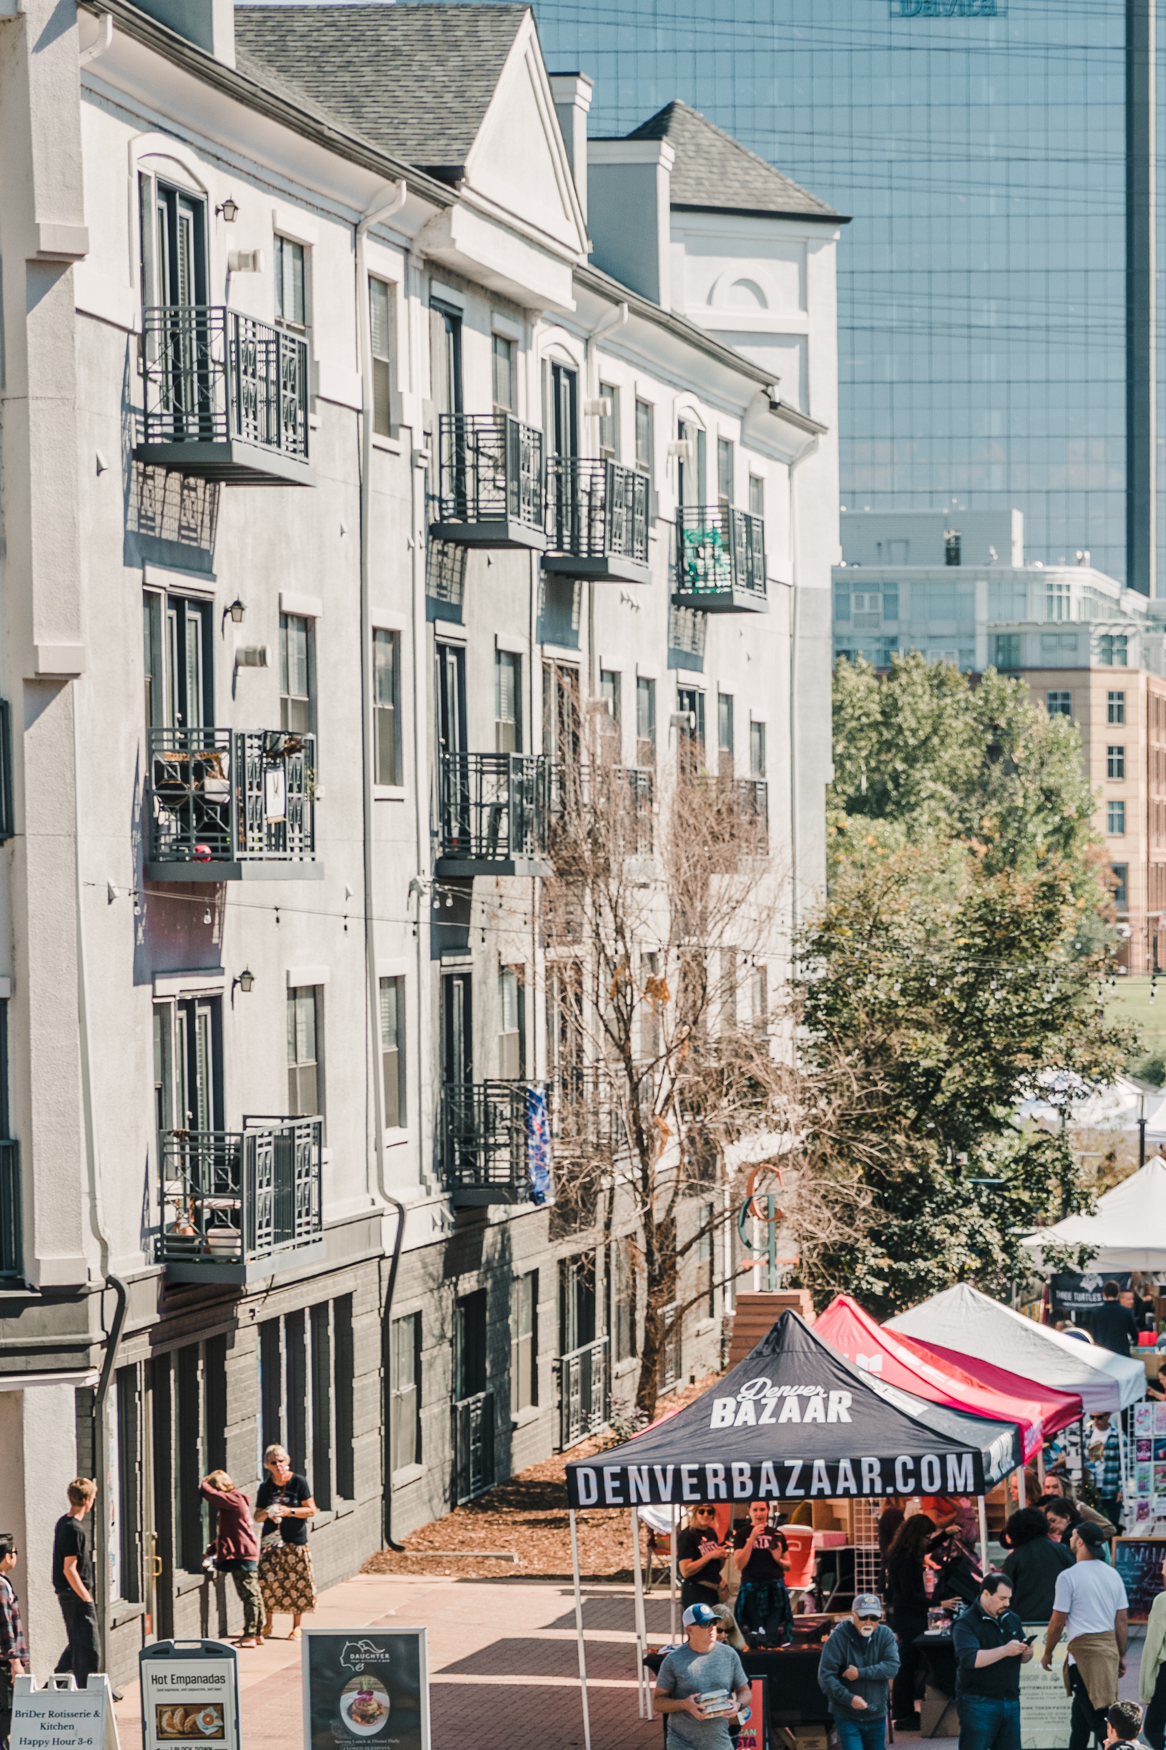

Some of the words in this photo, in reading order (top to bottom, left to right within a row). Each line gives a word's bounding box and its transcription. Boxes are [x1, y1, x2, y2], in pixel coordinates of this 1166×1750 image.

[1073, 1292, 1102, 1302] TURTLES
[737, 1377, 828, 1402] Denver
[710, 1390, 853, 1429] BAZAAR
[576, 1453, 975, 1506] DENVERBAZAAR.COM
[151, 1674, 168, 1685] Hot
[171, 1674, 226, 1686] Empanadas
[15, 1710, 46, 1719] BriDer
[48, 1710, 91, 1718] Rotisserie
[40, 1722, 75, 1731] Kitchen
[738, 1729, 757, 1737] CAN
[19, 1738, 49, 1748] Happy
[52, 1738, 76, 1746] Hour
[77, 1738, 93, 1746] 3-6
[736, 1737, 757, 1748] STA
